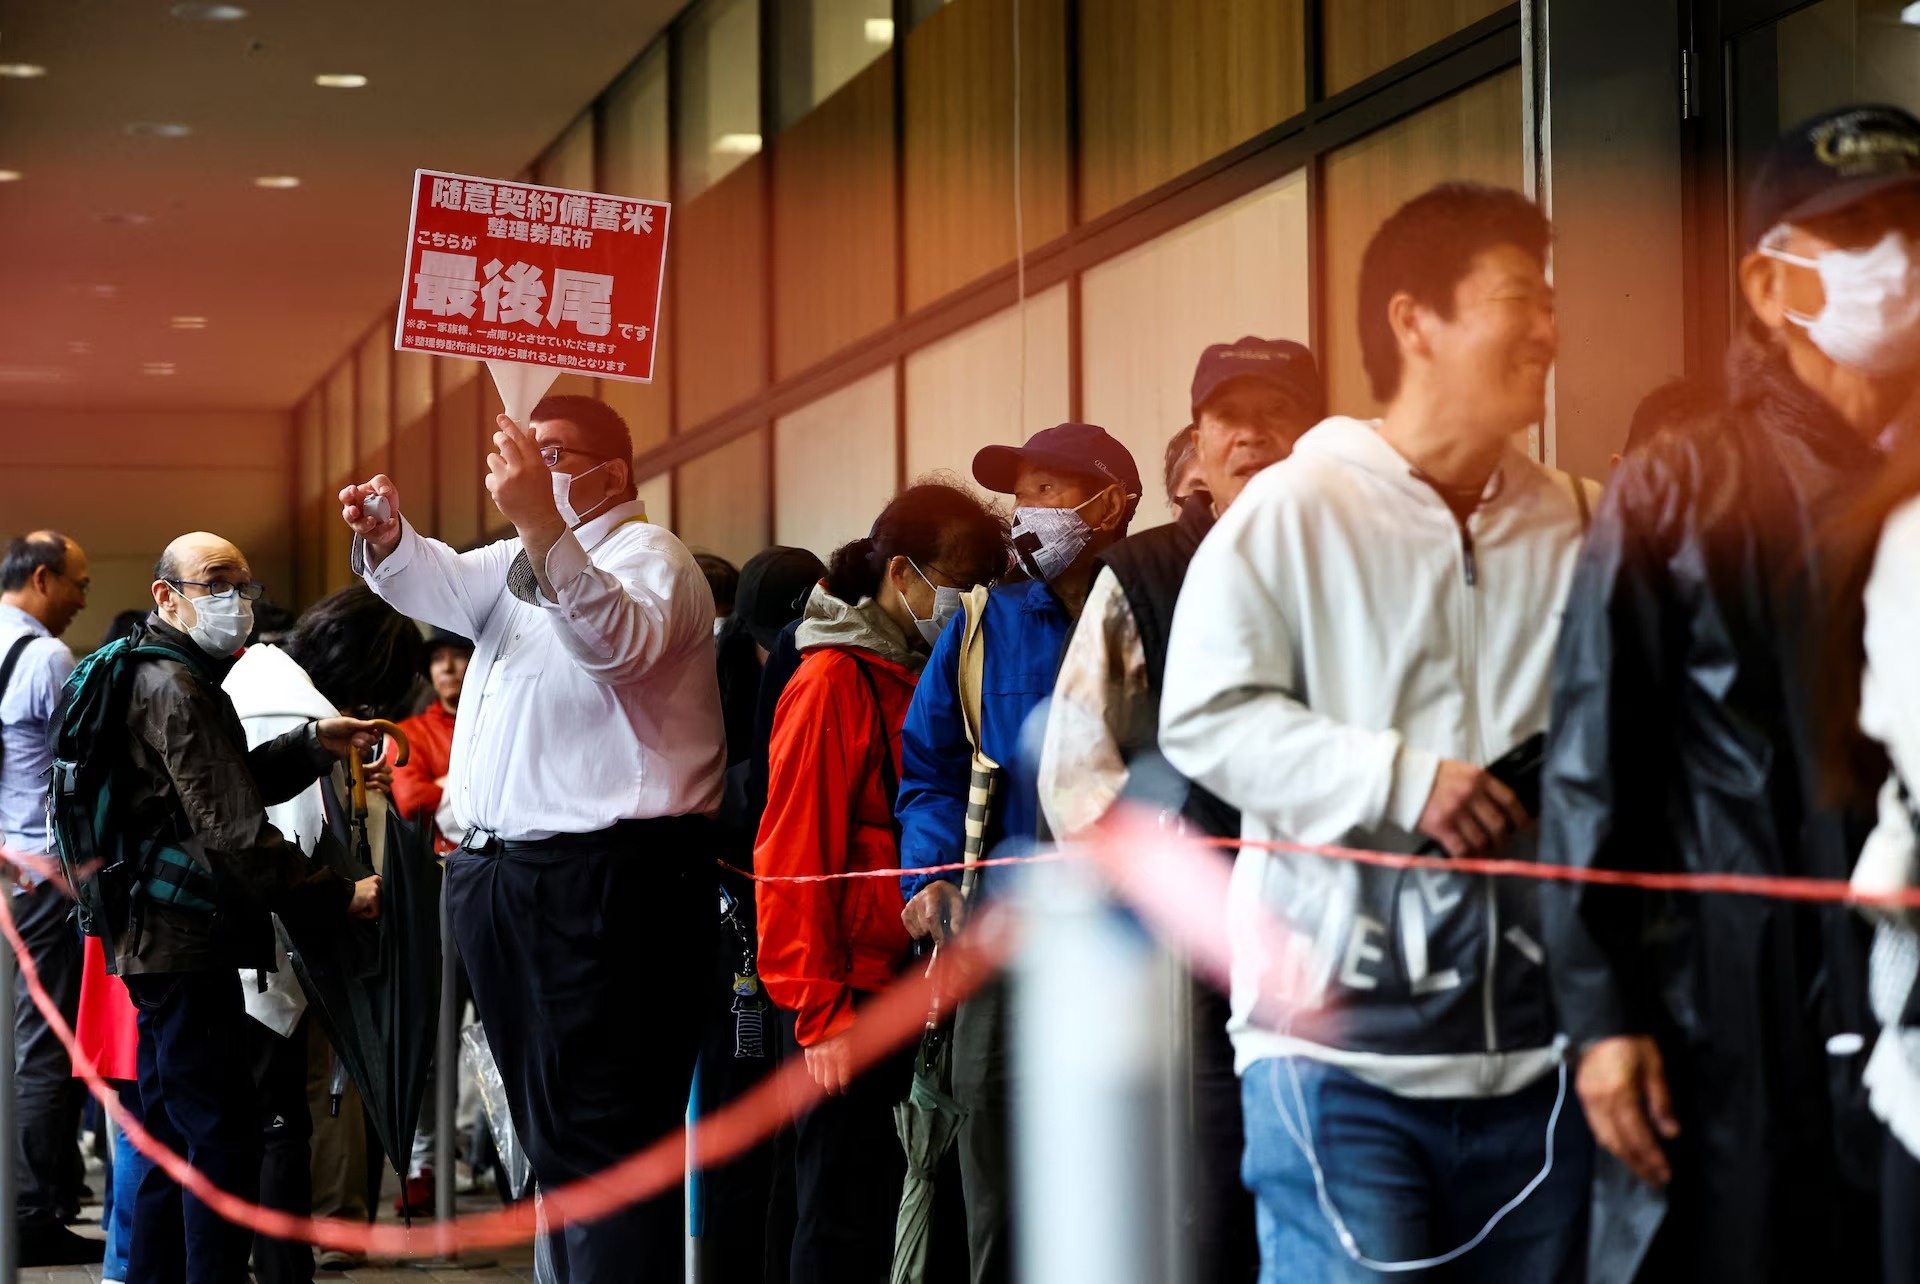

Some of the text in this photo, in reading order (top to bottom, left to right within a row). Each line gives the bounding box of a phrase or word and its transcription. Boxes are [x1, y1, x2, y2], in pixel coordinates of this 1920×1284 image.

[431, 178, 653, 235] 随意契約備蓄米
[416, 230, 477, 250] こちらが
[486, 217, 593, 249] 整理券配布
[413, 250, 614, 337] 最後尾
[618, 323, 650, 342] です
[404, 335, 627, 372] ※整理券配布後に列から離れると無効となります
